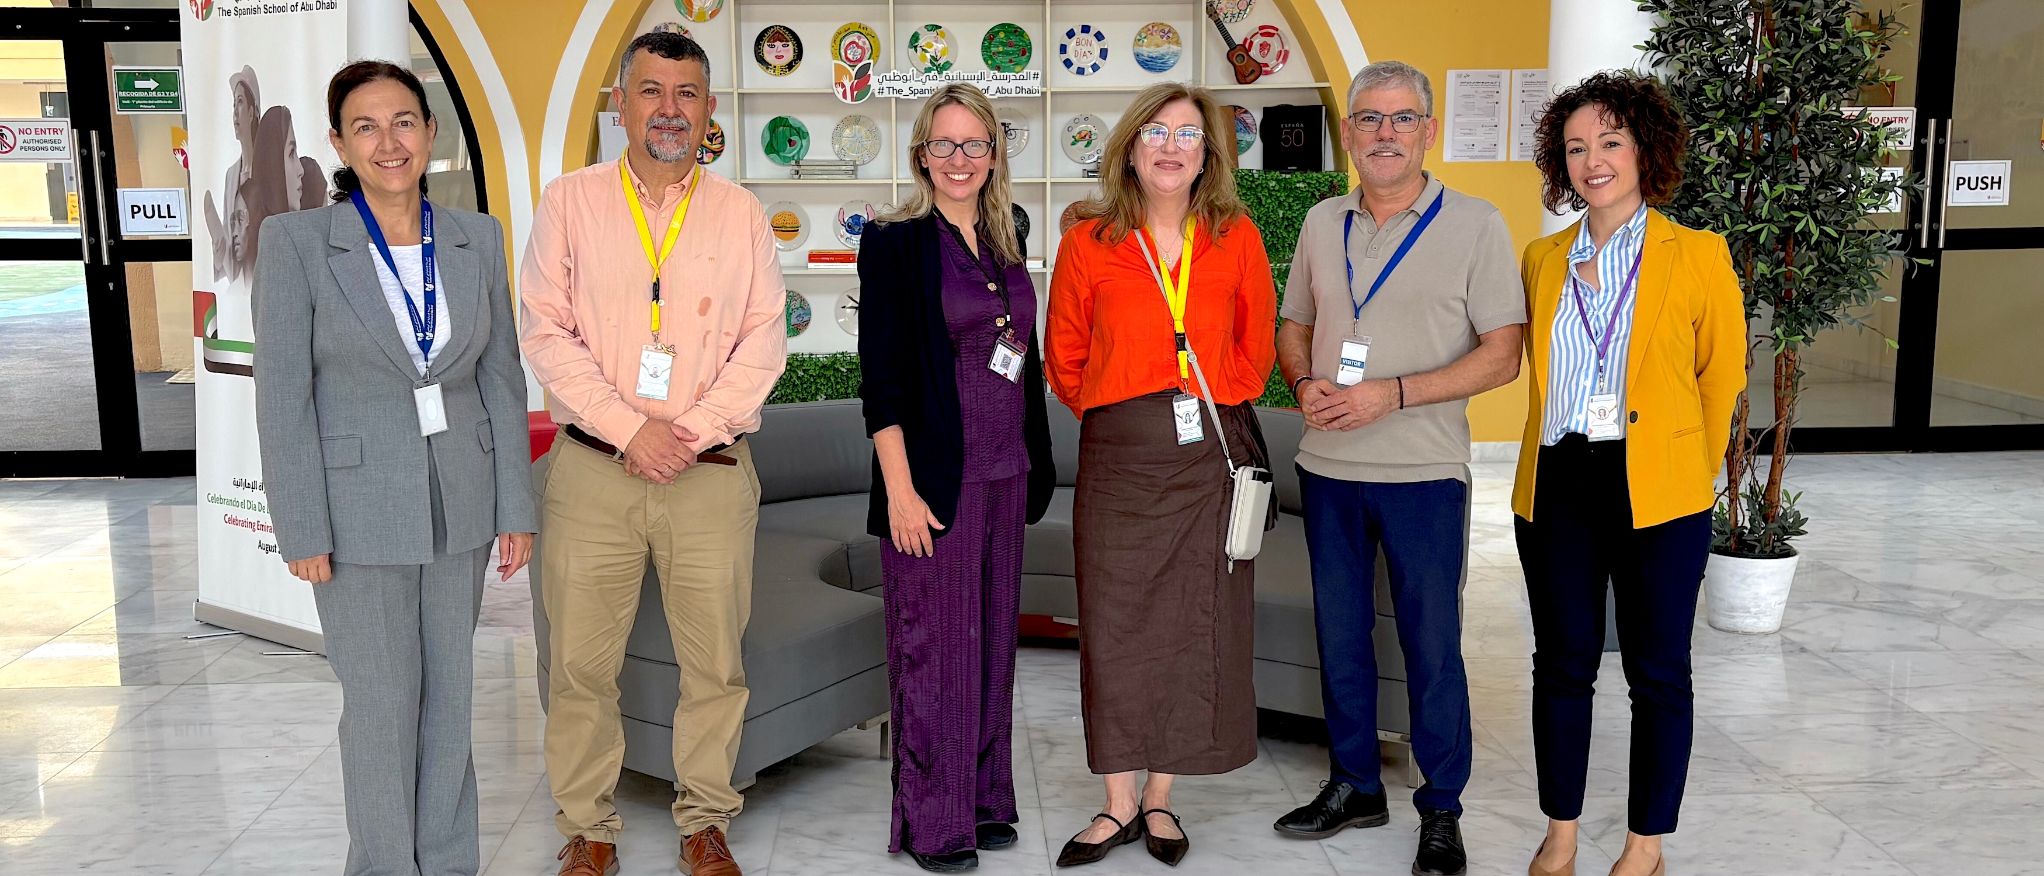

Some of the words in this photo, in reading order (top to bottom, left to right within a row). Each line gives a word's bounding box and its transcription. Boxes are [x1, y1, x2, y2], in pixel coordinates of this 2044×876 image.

[217, 7, 232, 17] The
[234, 5, 262, 18] Spanish
[264, 3, 288, 14] School
[290, 2, 299, 12] of
[301, 1, 314, 11] Abu
[316, 0, 338, 10] Dhabi
[1076, 38, 1093, 47] BON
[1015, 86, 1040, 95] Dhabi
[1280, 129, 1304, 148] 50
[1956, 176, 2002, 191] PUSH
[130, 204, 177, 219] PULL
[206, 492, 240, 509] Celebrando
[240, 500, 246, 510] el
[258, 501, 266, 514] De
[223, 513, 256, 533] Celebrating
[257, 540, 278, 555] August
